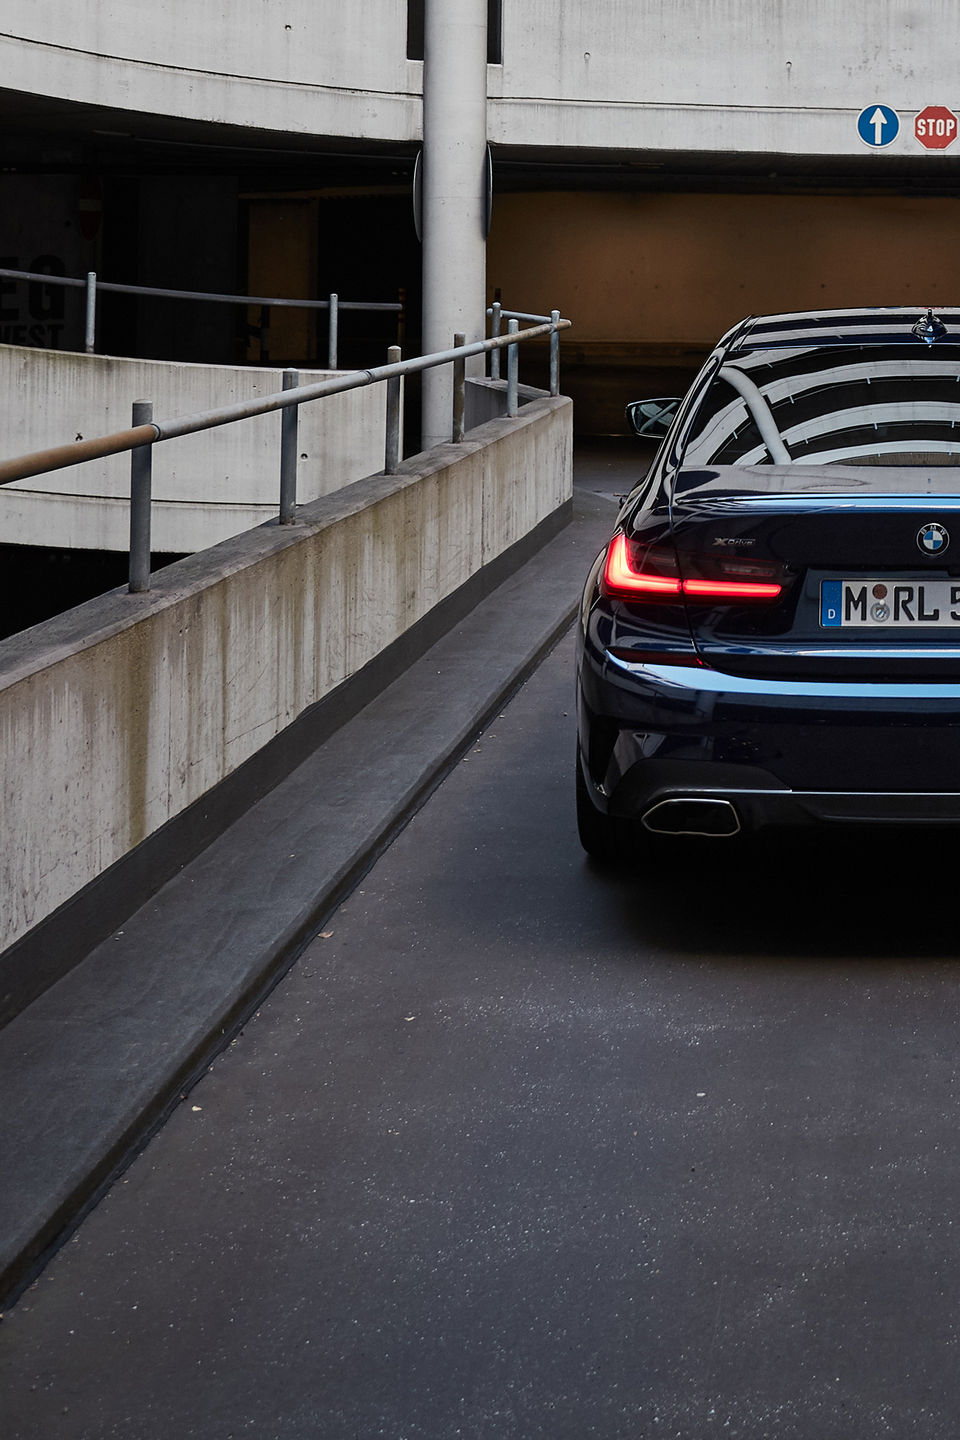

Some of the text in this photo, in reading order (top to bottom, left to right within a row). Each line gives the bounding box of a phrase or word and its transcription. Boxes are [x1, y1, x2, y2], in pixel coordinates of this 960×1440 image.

[917, 118, 955, 136] STOP
[828, 609, 836, 620] D
[845, 586, 867, 621] M
[893, 586, 940, 621] RL
